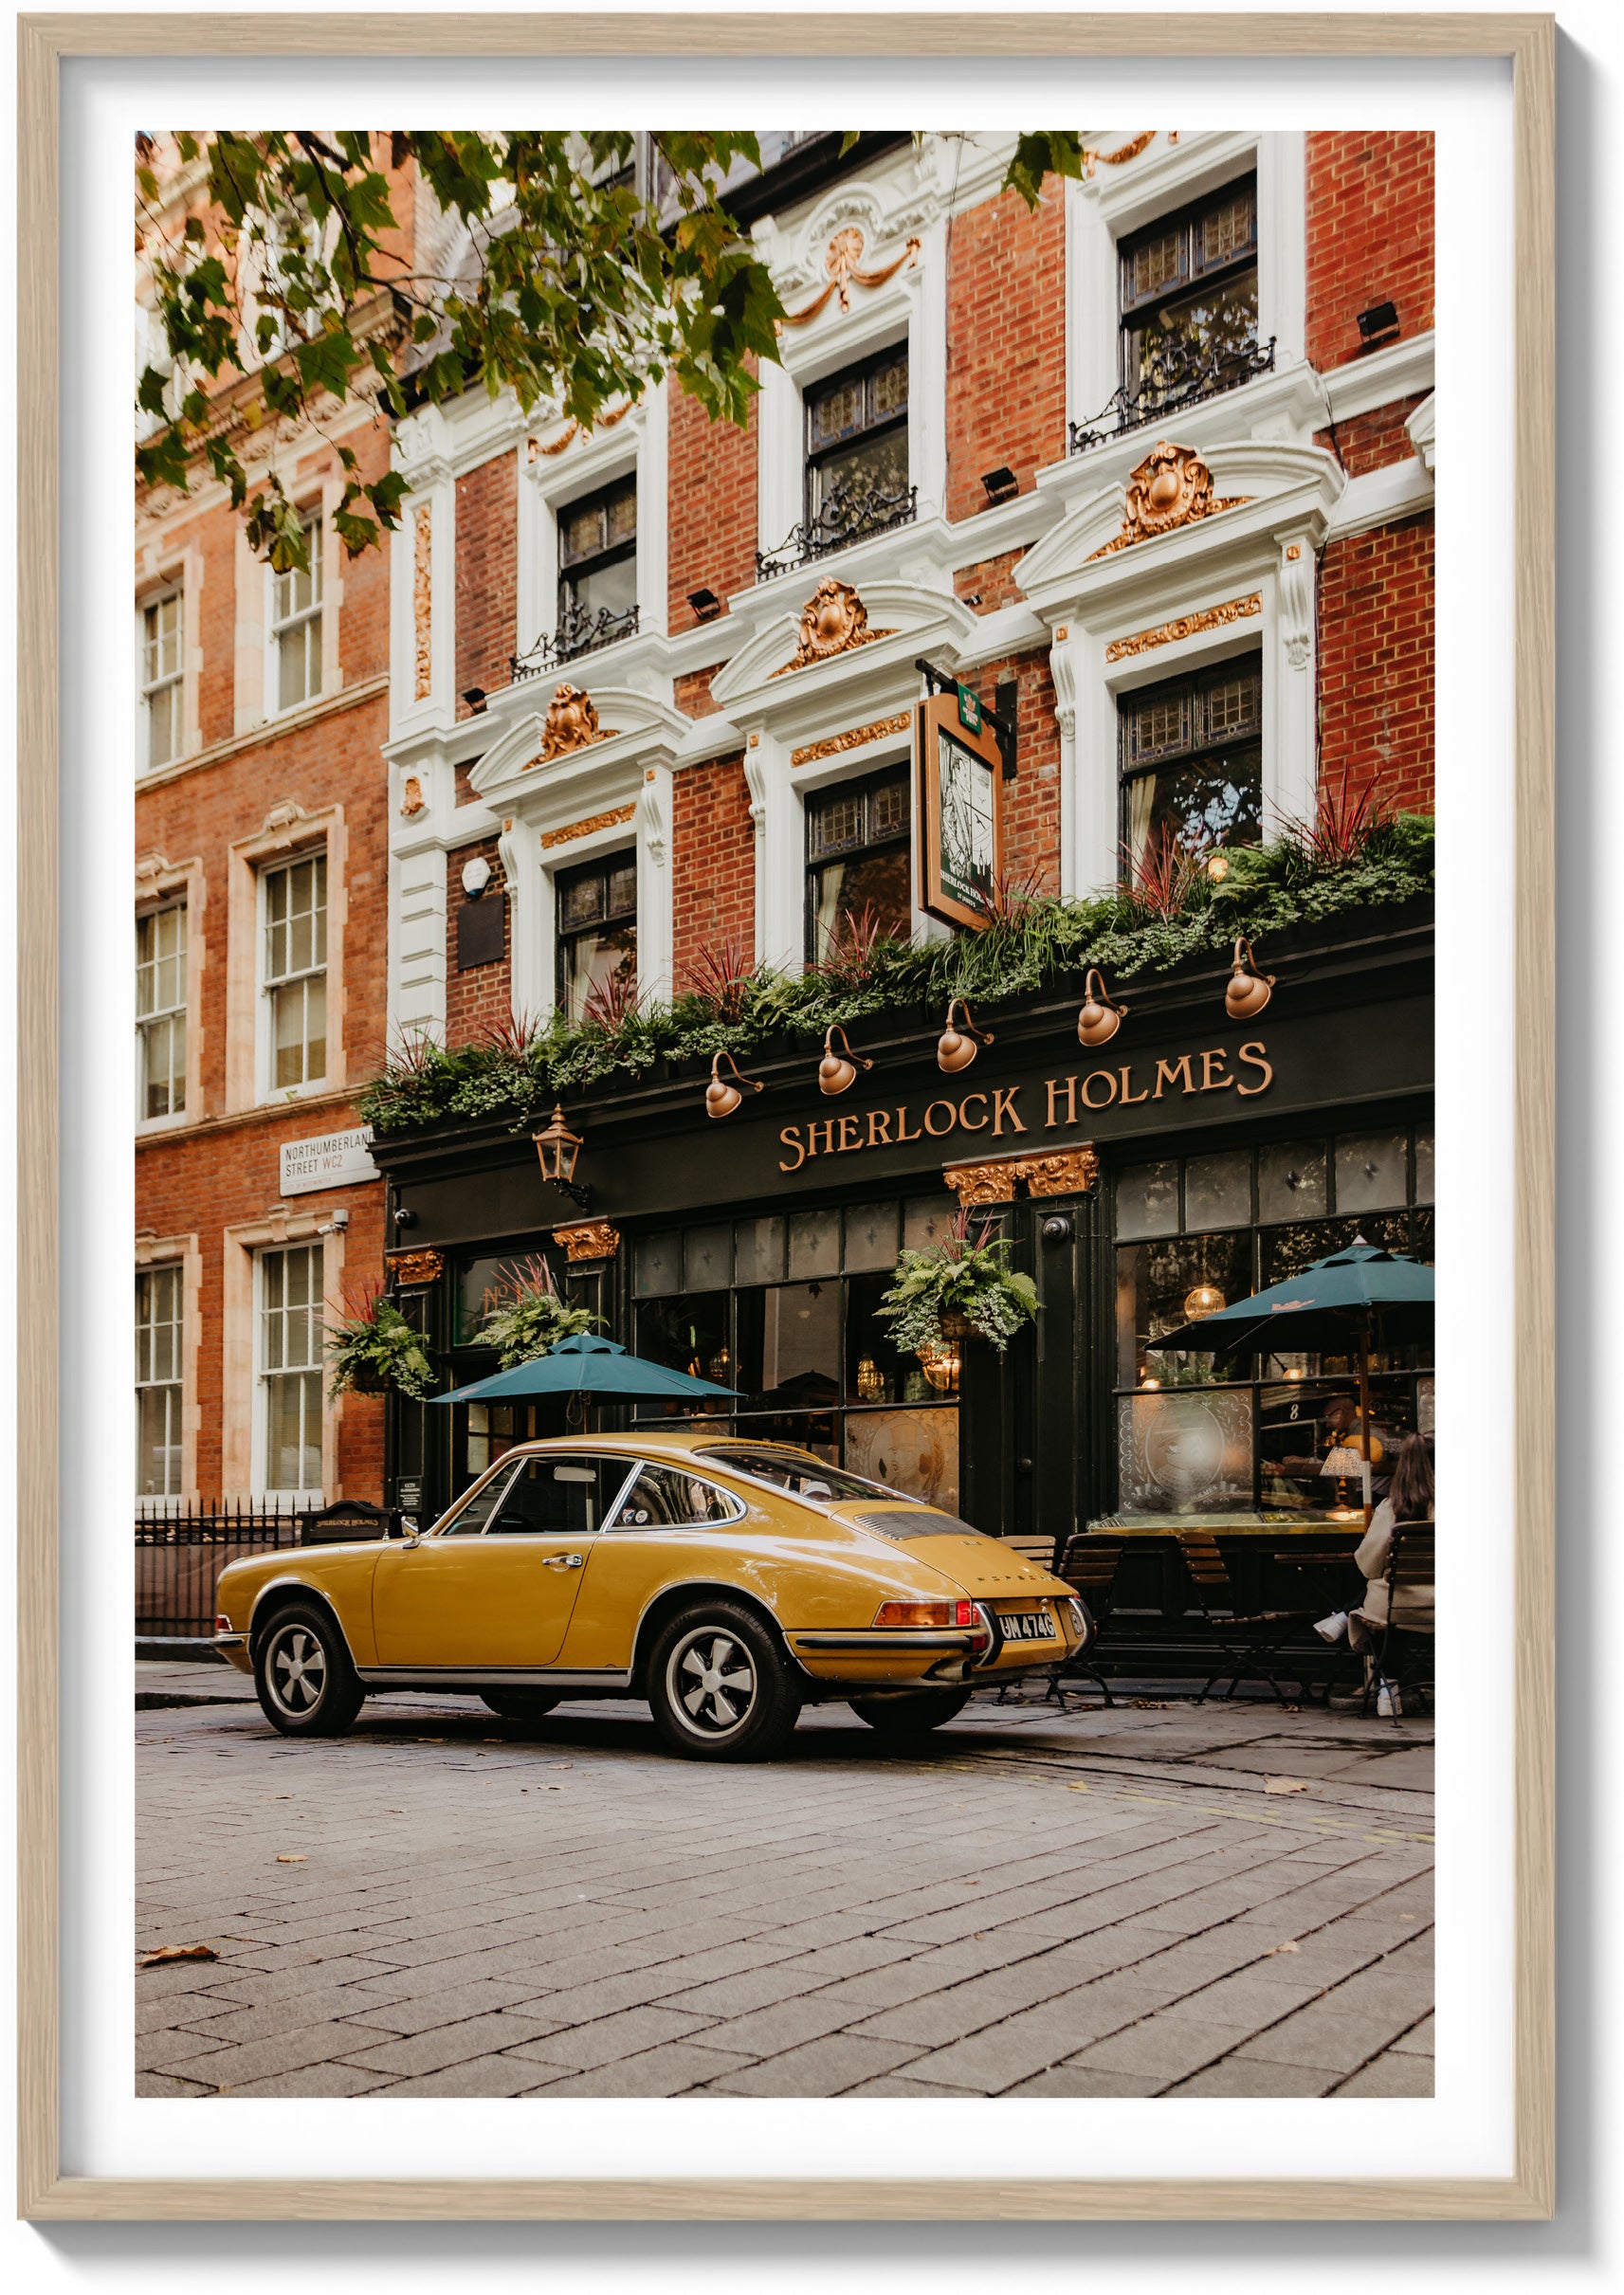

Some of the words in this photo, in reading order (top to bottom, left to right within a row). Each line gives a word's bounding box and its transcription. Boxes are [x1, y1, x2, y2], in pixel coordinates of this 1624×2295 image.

[940, 869, 971, 896] SHERLOCK
[778, 1085, 1029, 1172] SHERLOCK
[1044, 1042, 1273, 1127] HOLMES
[285, 1131, 375, 1161] NORTHUMBERLAND
[285, 1158, 319, 1177] STREET
[322, 1155, 343, 1170] WC2
[1289, 1403, 1299, 1420] 8
[1022, 1613, 1056, 1638] 474G
